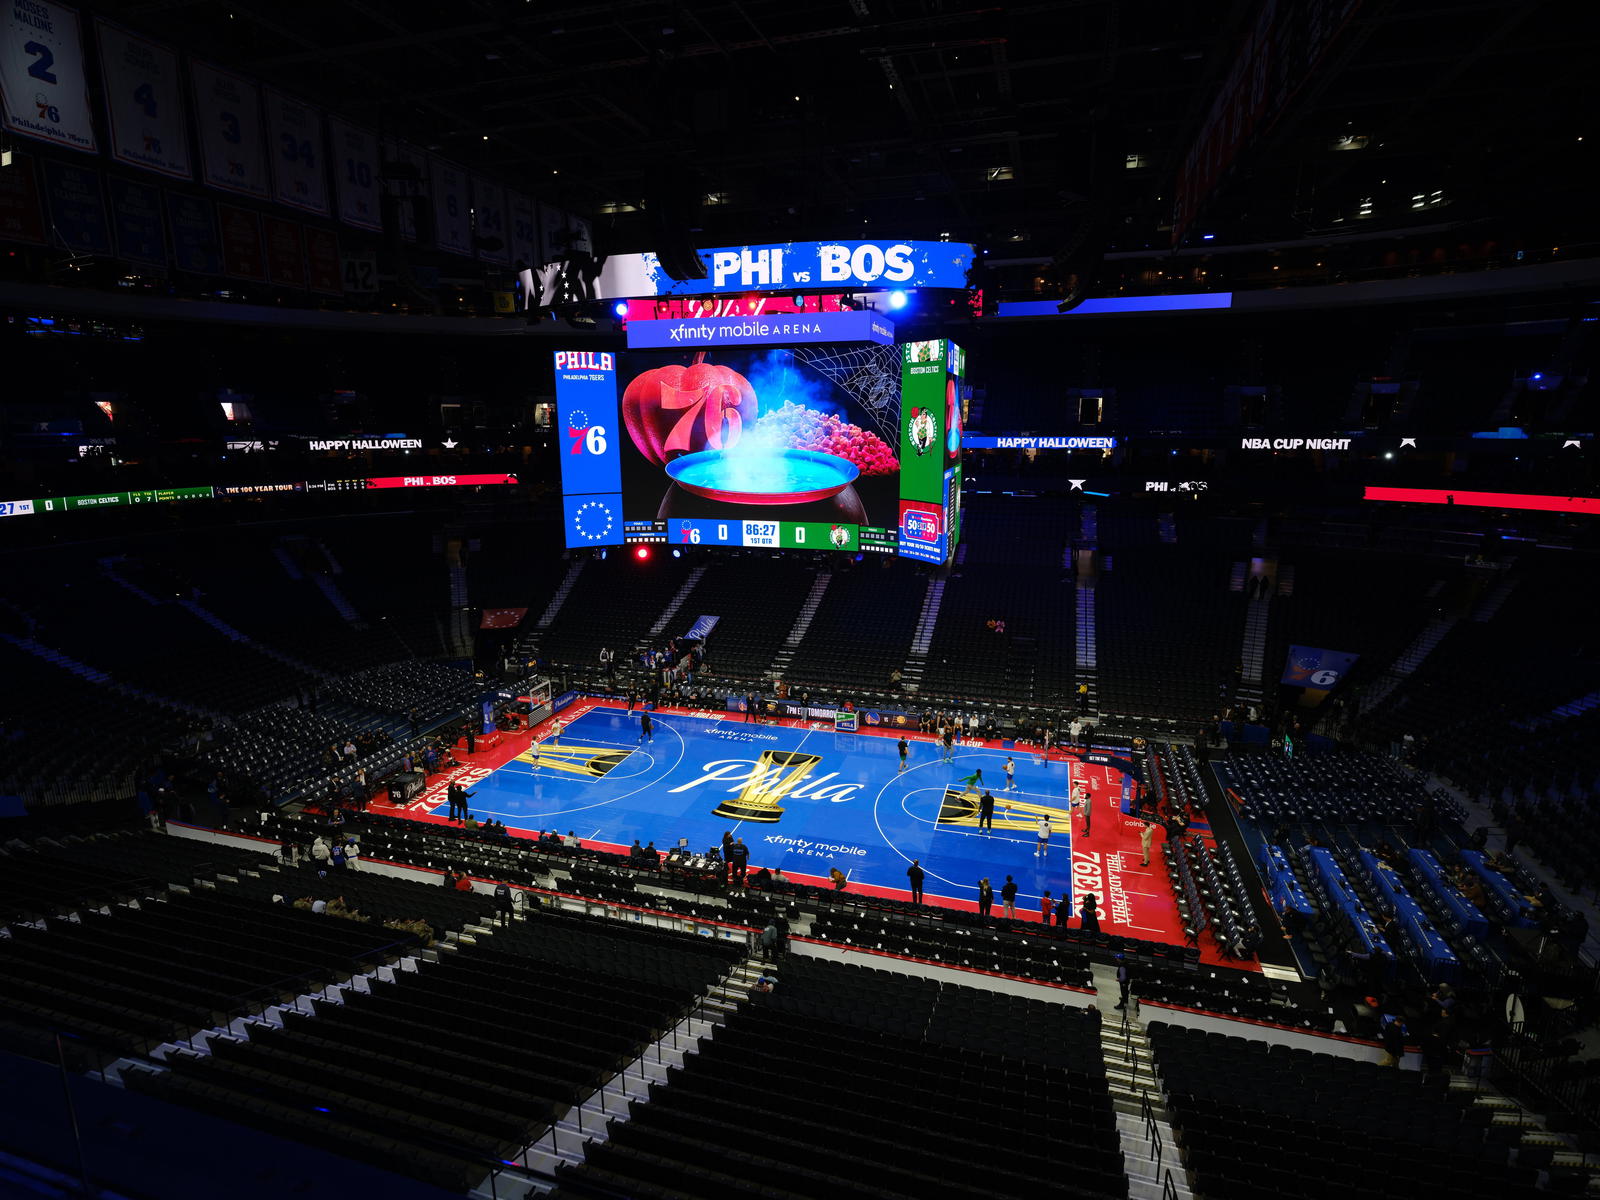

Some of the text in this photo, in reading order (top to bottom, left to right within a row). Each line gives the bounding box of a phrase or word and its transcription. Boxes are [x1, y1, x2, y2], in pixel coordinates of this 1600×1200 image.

[14, 8, 54, 34] MALONE
[24, 41, 57, 85] 2
[134, 83, 157, 118] 4
[36, 102, 60, 123] 76
[12, 116, 66, 139] Philadelphia
[220, 111, 241, 144] 3
[281, 132, 314, 169] 34
[347, 158, 371, 188] 10
[713, 248, 784, 287] PHI
[821, 244, 915, 282] BOS
[345, 261, 376, 290] 42
[669, 321, 822, 341] xfinity mobile ARENA
[555, 351, 614, 371] PHILA
[660, 380, 743, 451] 76
[309, 438, 423, 450] HAPPY HALLOWEEN
[567, 425, 608, 455] 76
[997, 437, 1113, 448] HAPPY HALLOWEEN
[1242, 438, 1351, 451] NBA CUP NIGHT
[254, 485, 274, 493] YEAR
[276, 484, 293, 492] TOUR
[404, 477, 424, 486] PHI
[432, 476, 457, 486] BOS
[1145, 481, 1168, 492] PHI
[45, 501, 53, 511] 0
[77, 496, 119, 506] BOSTON CELTICS
[718, 524, 728, 540] 0
[745, 523, 776, 536] 86:27
[795, 526, 806, 543] 0
[907, 519, 936, 533] 50 50
[681, 528, 701, 544] 76
[761, 537, 773, 545] QTR
[786, 705, 797, 715] 7PM
[703, 728, 779, 741] xfinity mobile
[667, 759, 865, 803] Phila
[391, 790, 402, 799] 76
[763, 834, 867, 857] xfinity mobile
[785, 847, 835, 859] ARENA
[1105, 853, 1127, 924] PHILADELPHIA
